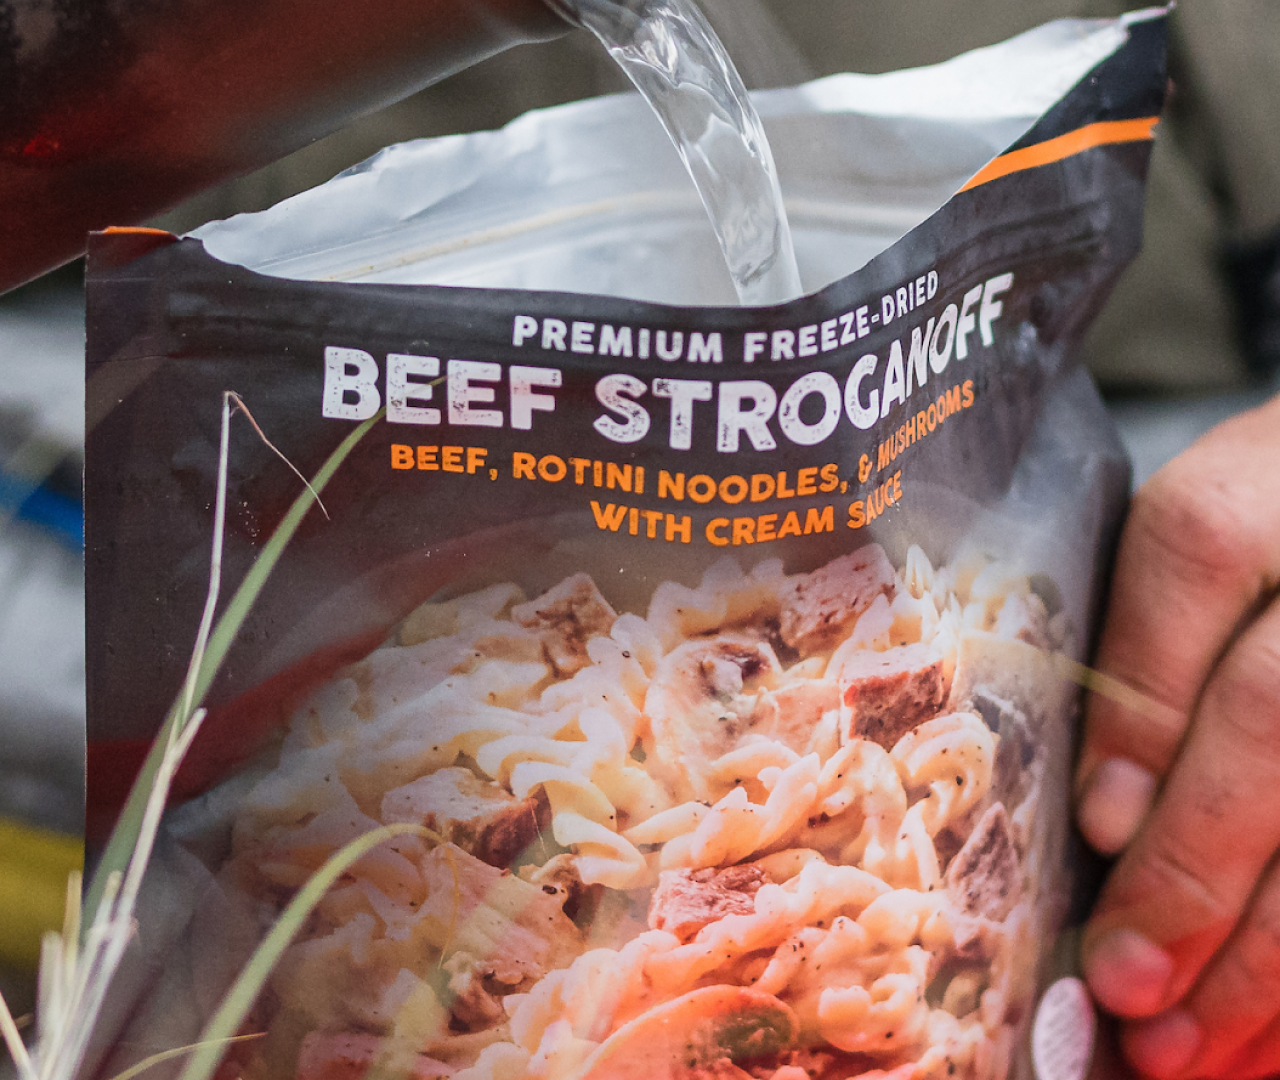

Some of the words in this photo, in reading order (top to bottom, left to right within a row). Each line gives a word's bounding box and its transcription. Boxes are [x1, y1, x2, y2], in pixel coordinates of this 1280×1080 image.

[321, 344, 563, 431] BEEF
[592, 272, 1014, 453] STROGANOFF
[512, 315, 723, 362] PREMIUM
[743, 270, 939, 362] FREEZE-DRIED
[390, 443, 498, 482] BEEF,
[511, 451, 645, 495] ROTINI
[657, 463, 848, 504] NOODLES,
[858, 453, 873, 483] &
[877, 379, 975, 472] MUSHROOMS
[590, 500, 692, 544] WITH
[706, 506, 835, 547] CREAM
[847, 469, 903, 530] SAUCE
